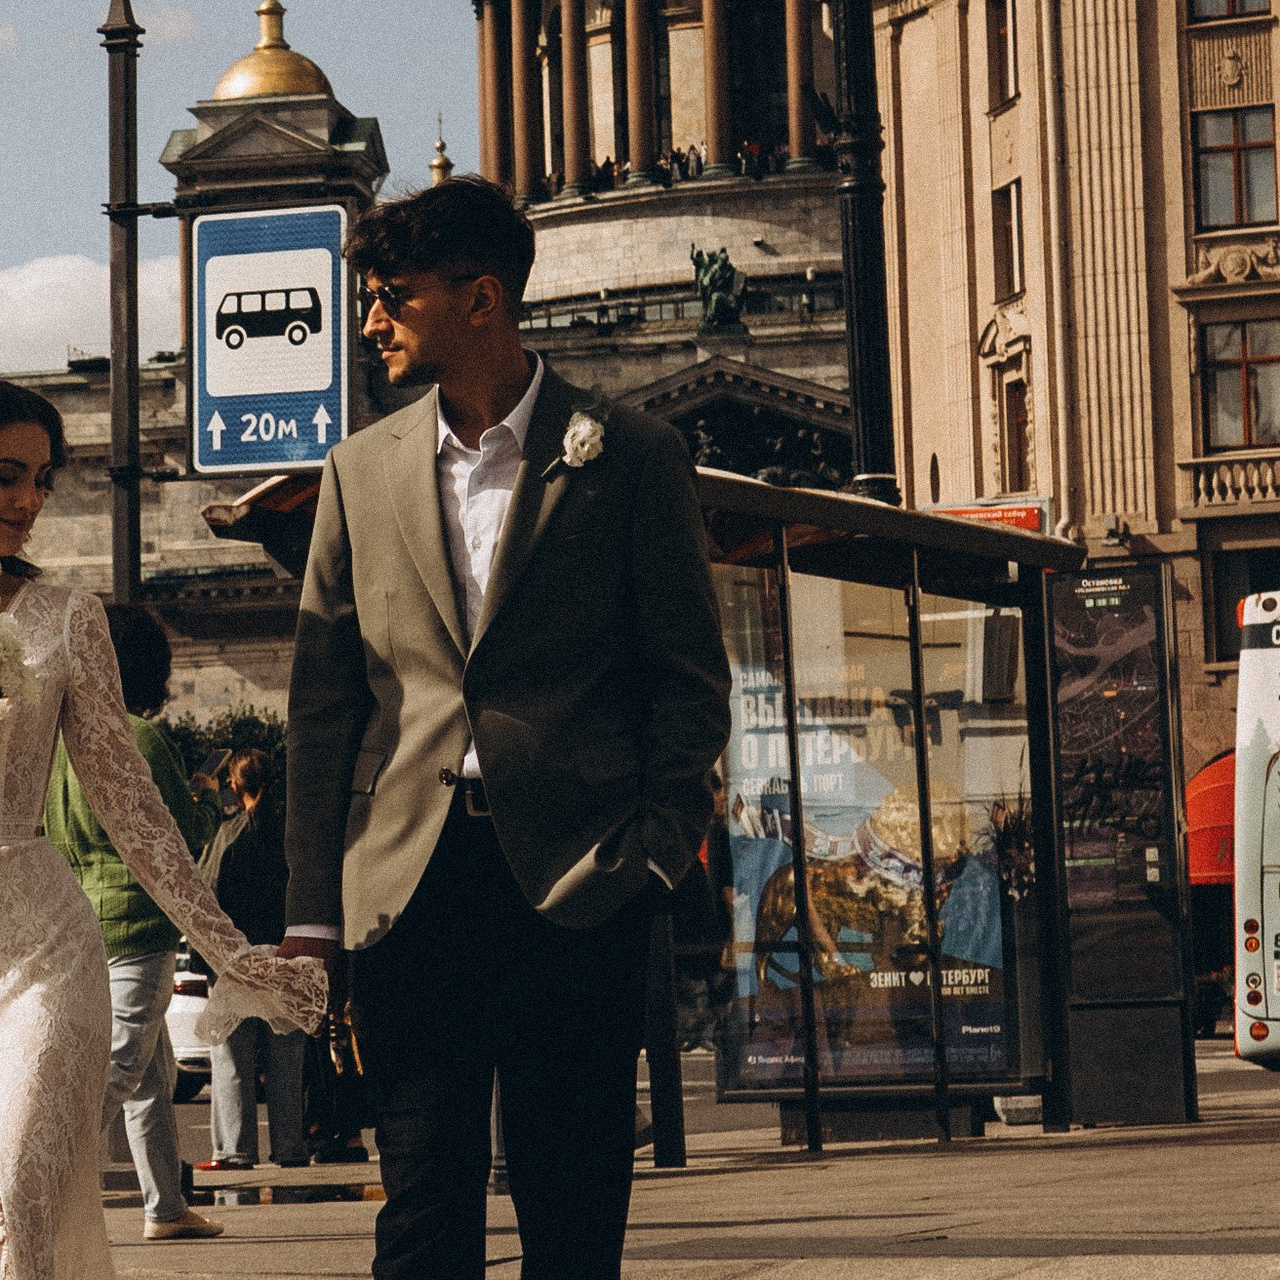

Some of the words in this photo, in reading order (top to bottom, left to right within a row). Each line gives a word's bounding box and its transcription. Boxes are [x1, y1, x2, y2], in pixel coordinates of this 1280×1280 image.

[1081, 578, 1123, 588] Остановка
[741, 686, 892, 730] ВЫТАВКА
[741, 733, 759, 770] О
[770, 723, 933, 769] ПТЕРБУРГ
[742, 776, 808, 796] СЕВКАБЬ
[813, 773, 843, 792] ПОРТ
[870, 971, 906, 988] ЗЕНИТ
[926, 969, 990, 986] ТЕРБУРГ
[961, 1025, 1001, 1035] Planet9
